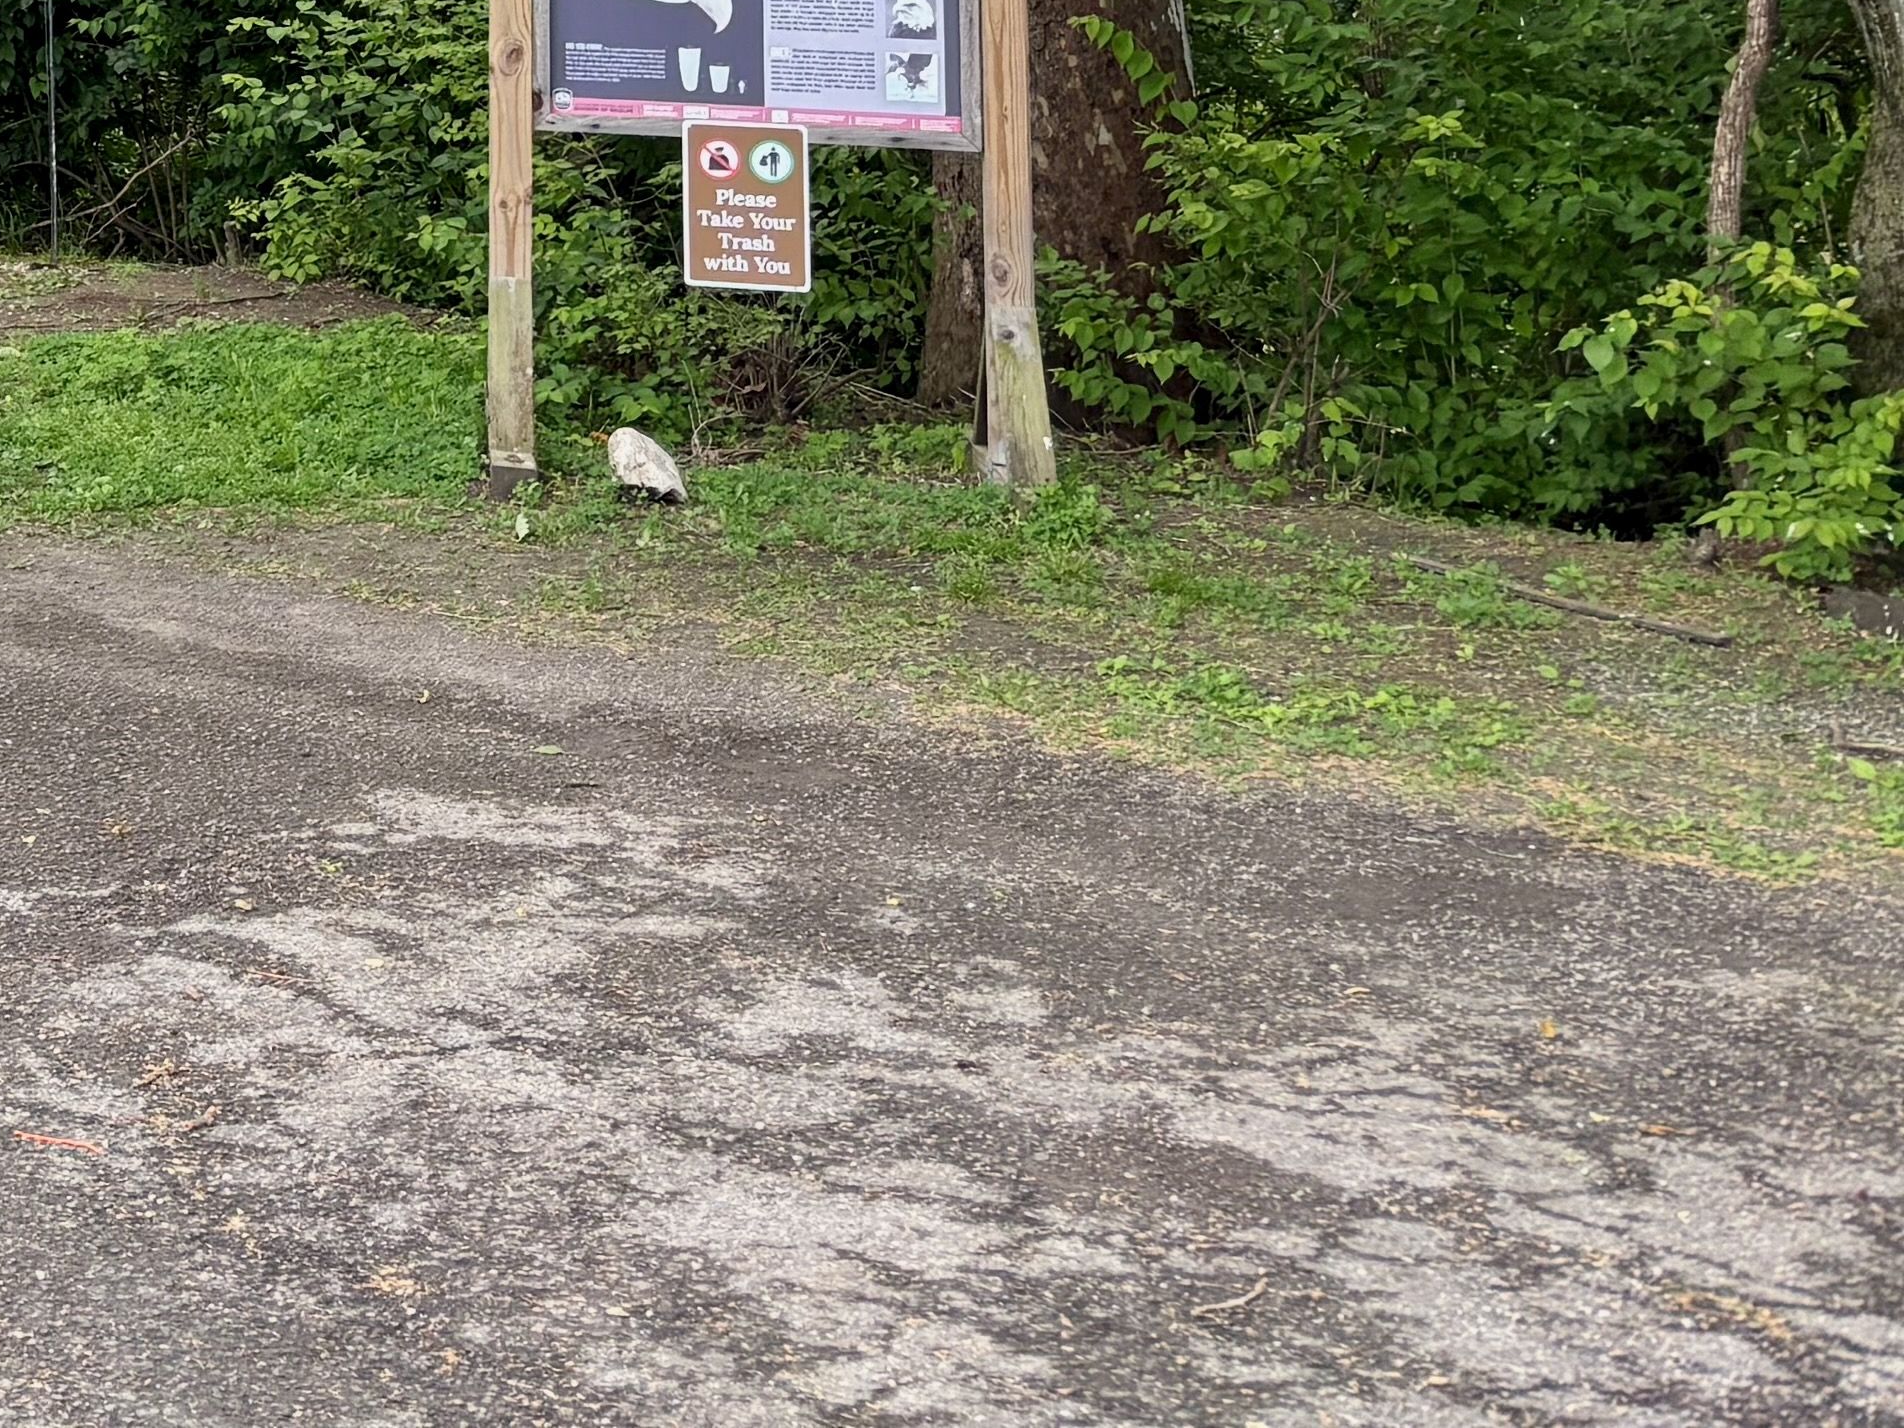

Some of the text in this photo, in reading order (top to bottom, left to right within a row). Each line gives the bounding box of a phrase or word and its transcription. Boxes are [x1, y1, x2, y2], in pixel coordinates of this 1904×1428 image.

[716, 189, 776, 208] Please
[697, 210, 796, 231] Take Your
[718, 233, 775, 251] Trash
[704, 254, 790, 275] with You
